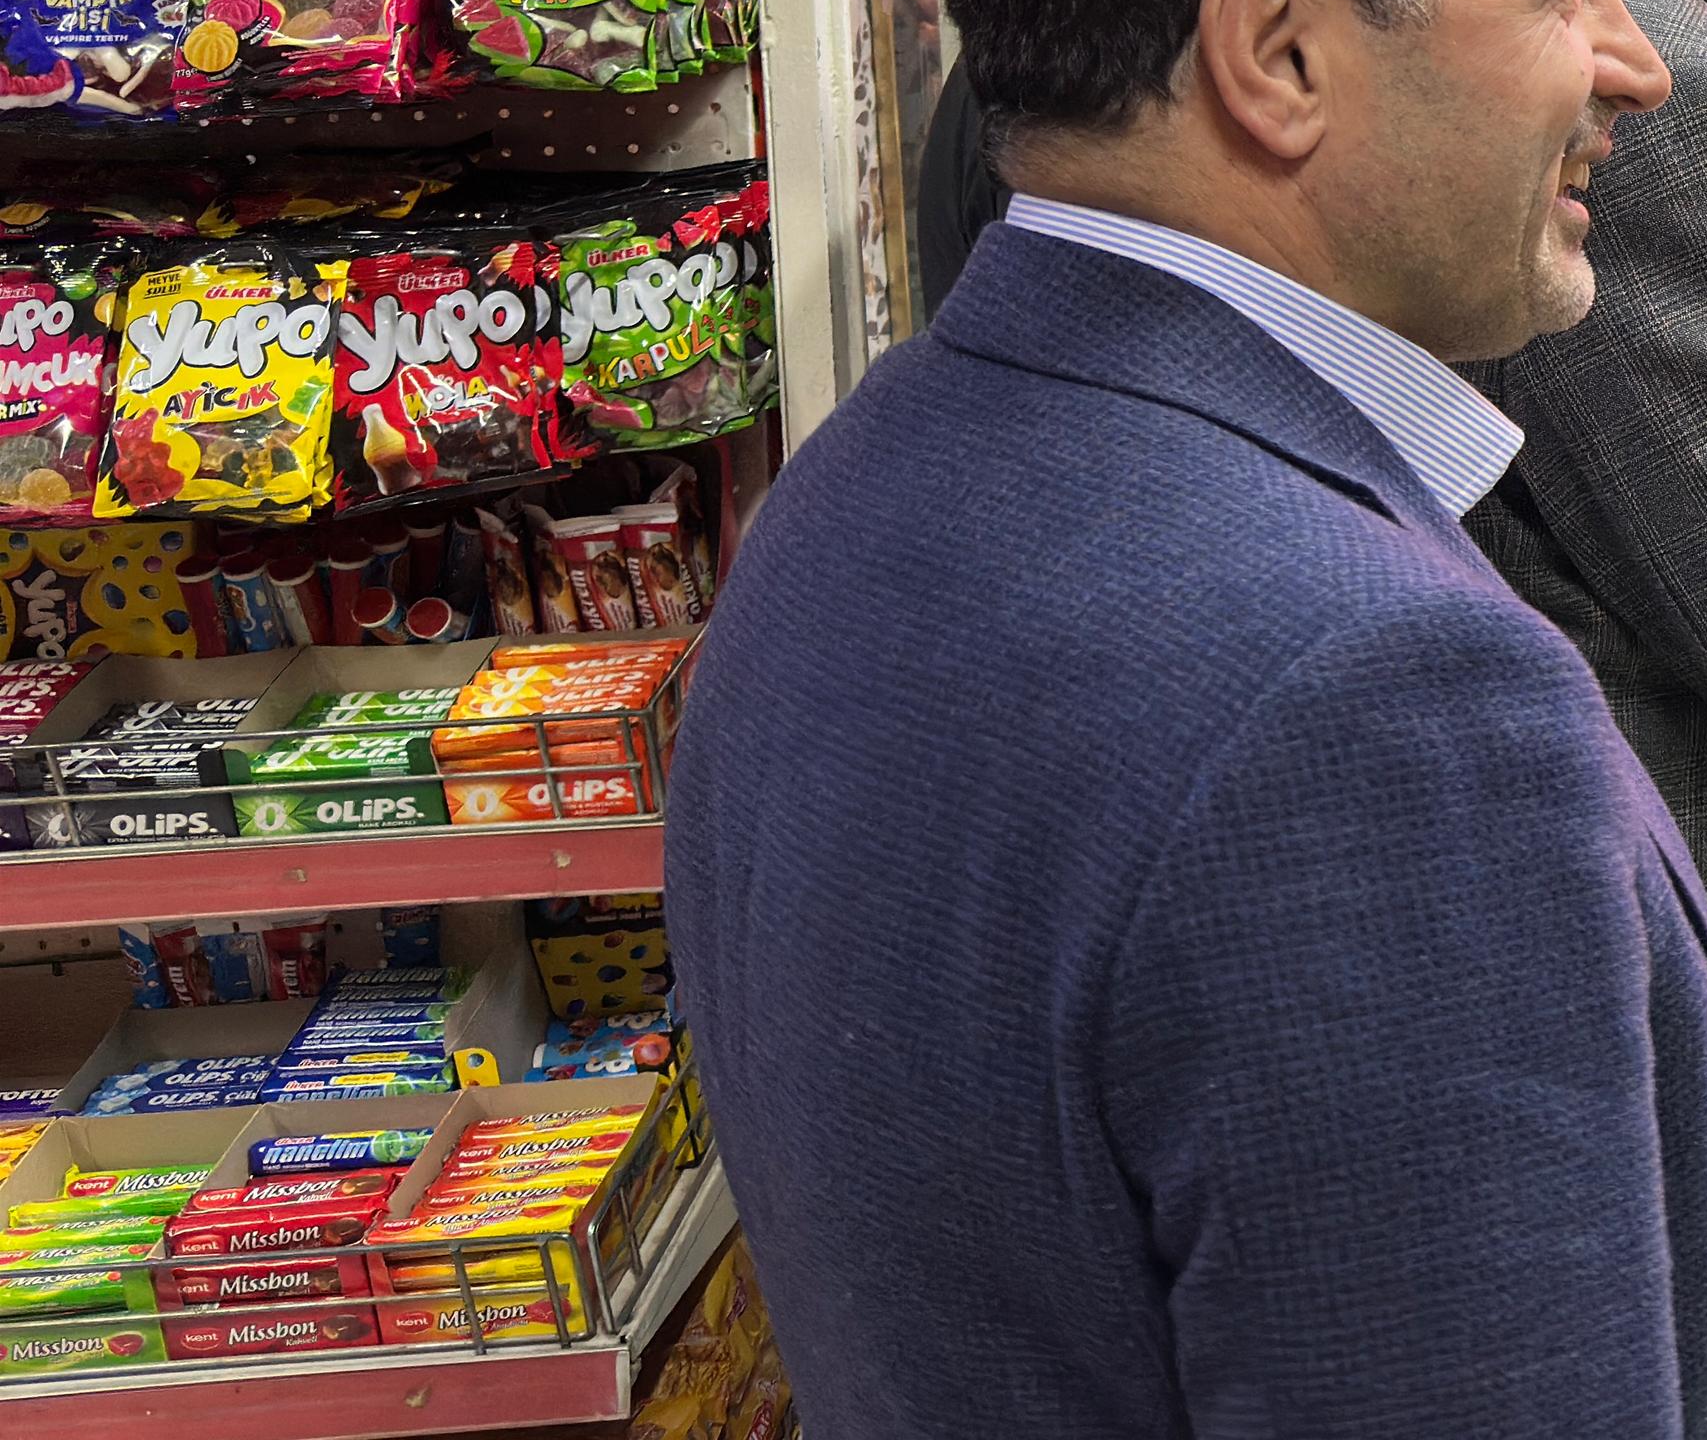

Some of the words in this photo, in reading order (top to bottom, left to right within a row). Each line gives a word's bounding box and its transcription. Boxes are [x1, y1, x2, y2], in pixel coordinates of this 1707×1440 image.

[45, 33, 93, 45] VAMPIRE
[95, 32, 129, 44] TEETH
[586, 244, 653, 266] ÜLKER
[205, 283, 275, 300] ÜLKER
[398, 270, 465, 292] ÜLKER
[597, 322, 713, 391] KARPUZ
[72, 1177, 111, 1192] kent
[117, 1169, 209, 1195] Missbon
[200, 1190, 239, 1202] kent
[243, 1177, 340, 1202] Missbon
[181, 1240, 221, 1253] kent
[230, 1223, 321, 1252] Missbon
[219, 1268, 311, 1296] Missbon
[185, 1331, 219, 1343] kent
[228, 1319, 318, 1346] Missbon
[396, 1317, 429, 1328] kent
[13, 1336, 103, 1361] Missbon
